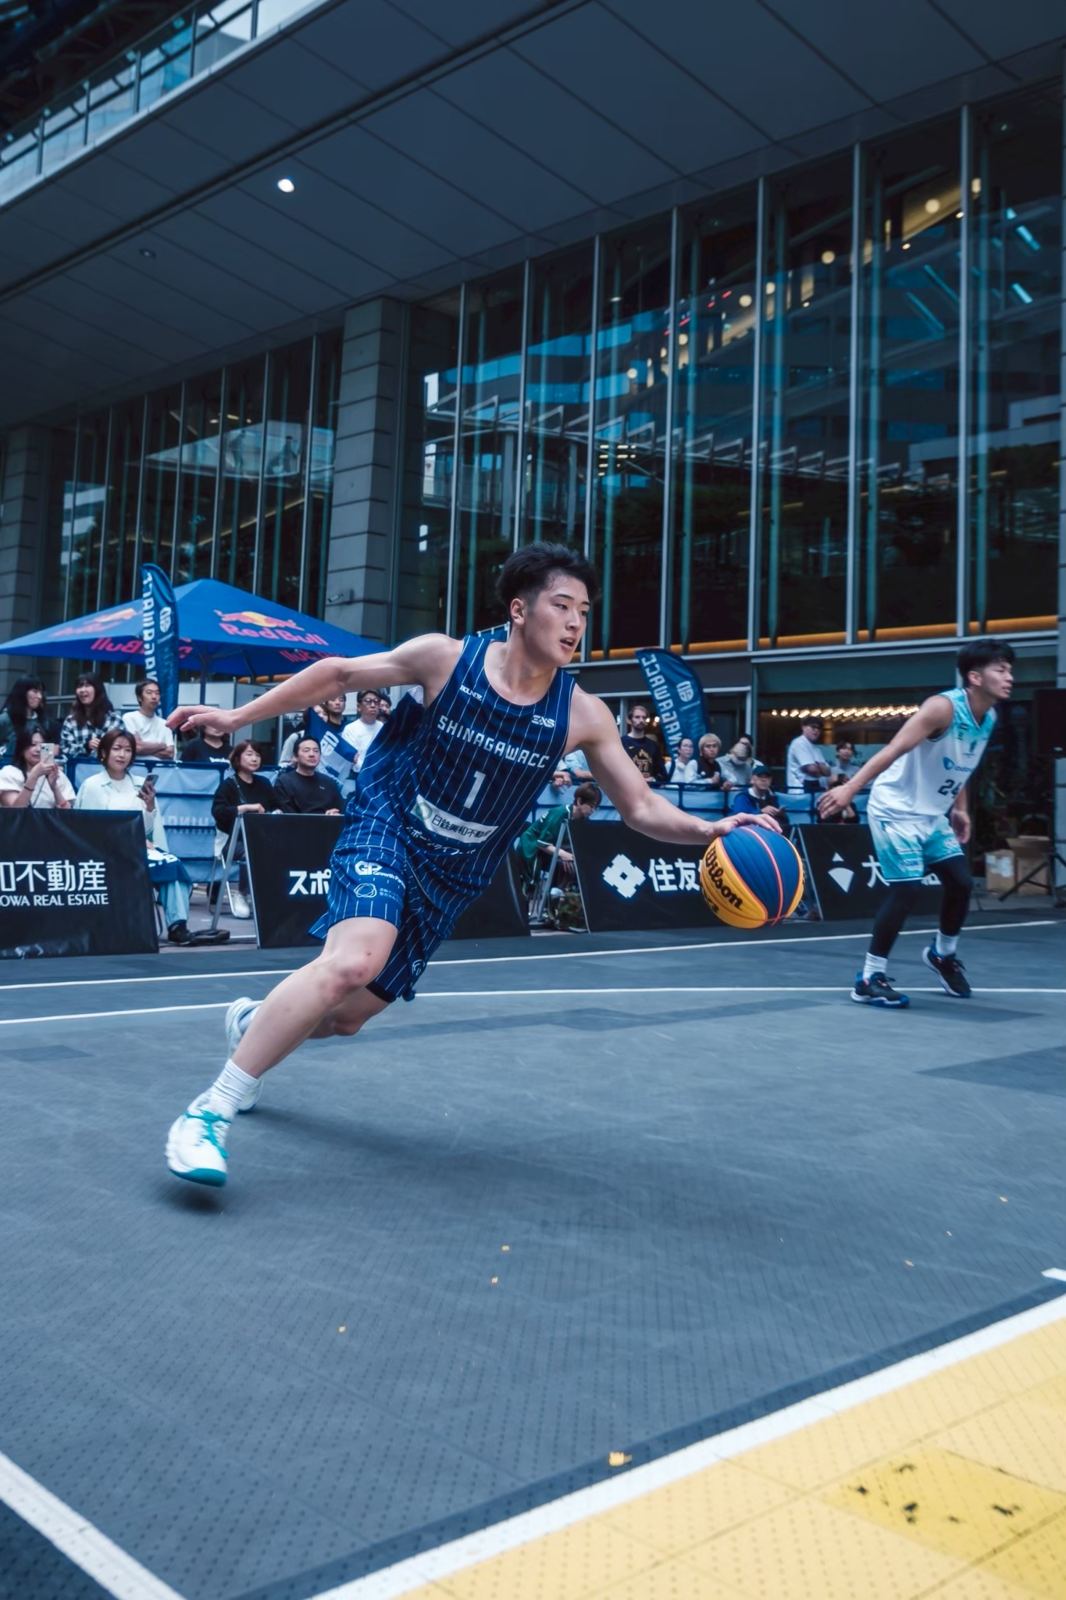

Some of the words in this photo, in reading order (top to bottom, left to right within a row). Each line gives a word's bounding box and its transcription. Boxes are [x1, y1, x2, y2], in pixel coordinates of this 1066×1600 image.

[437, 715, 550, 768] SHINAGAWACC
[463, 770, 486, 809] 1
[648, 858, 702, 892] 住友
[705, 846, 743, 911] Wilson
[0, 894, 31, 907] OWA
[33, 894, 65, 906] REAL
[67, 893, 109, 906] ESTATE
